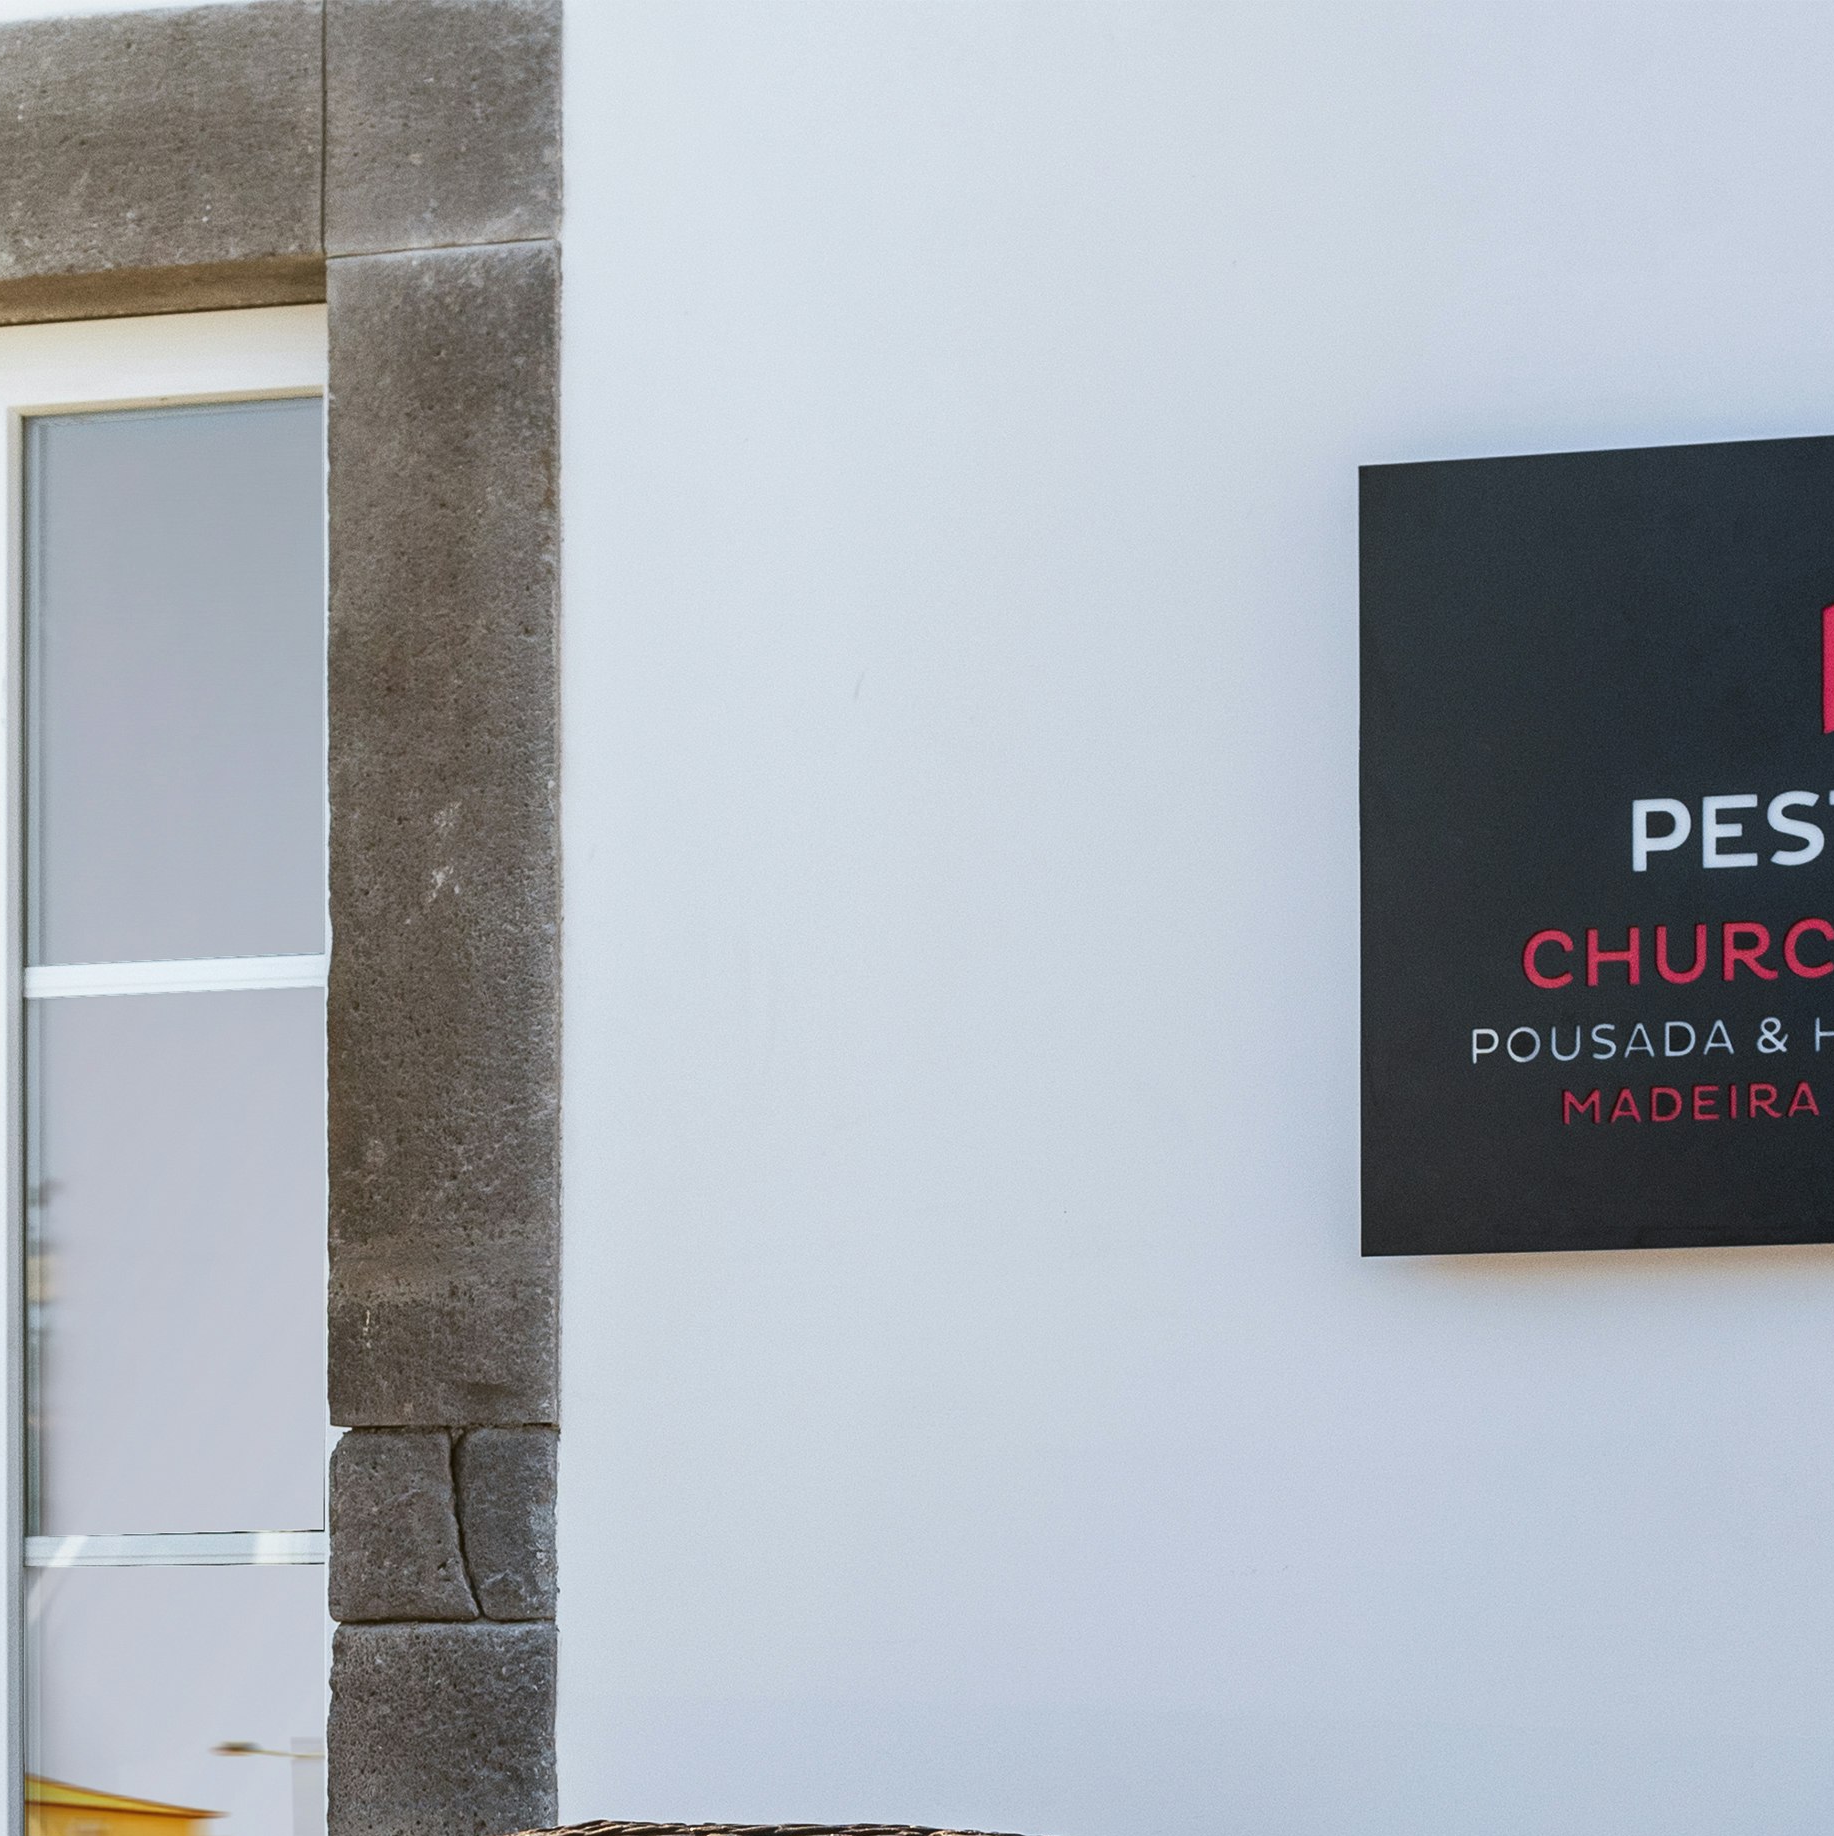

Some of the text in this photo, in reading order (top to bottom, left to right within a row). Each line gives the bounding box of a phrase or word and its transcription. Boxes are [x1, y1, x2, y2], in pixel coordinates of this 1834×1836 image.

[1470, 1018, 1736, 1066] POUSADA
[1755, 1015, 1790, 1055] &
[1562, 1081, 1820, 1125] MADEIRA
